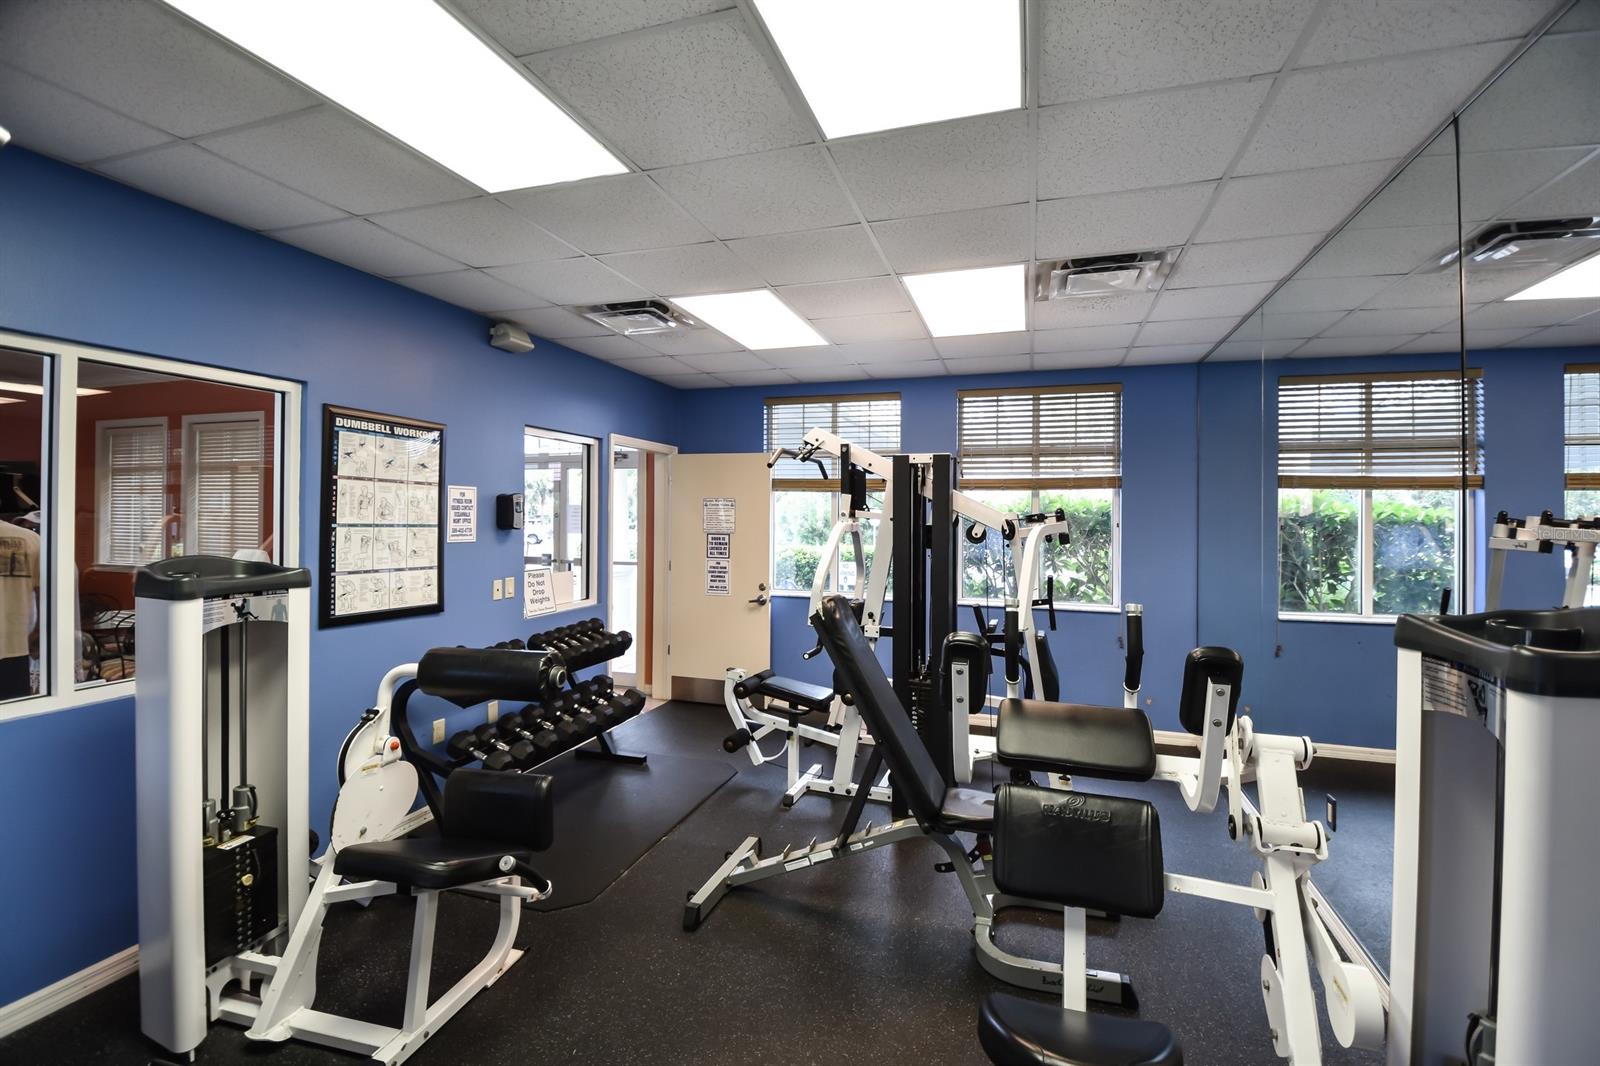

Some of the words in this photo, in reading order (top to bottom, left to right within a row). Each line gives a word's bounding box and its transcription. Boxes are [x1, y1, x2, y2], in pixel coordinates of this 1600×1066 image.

[336, 417, 391, 434] DUMBBELL
[394, 426, 440, 440] WORKOUT
[530, 596, 550, 605] Weights
